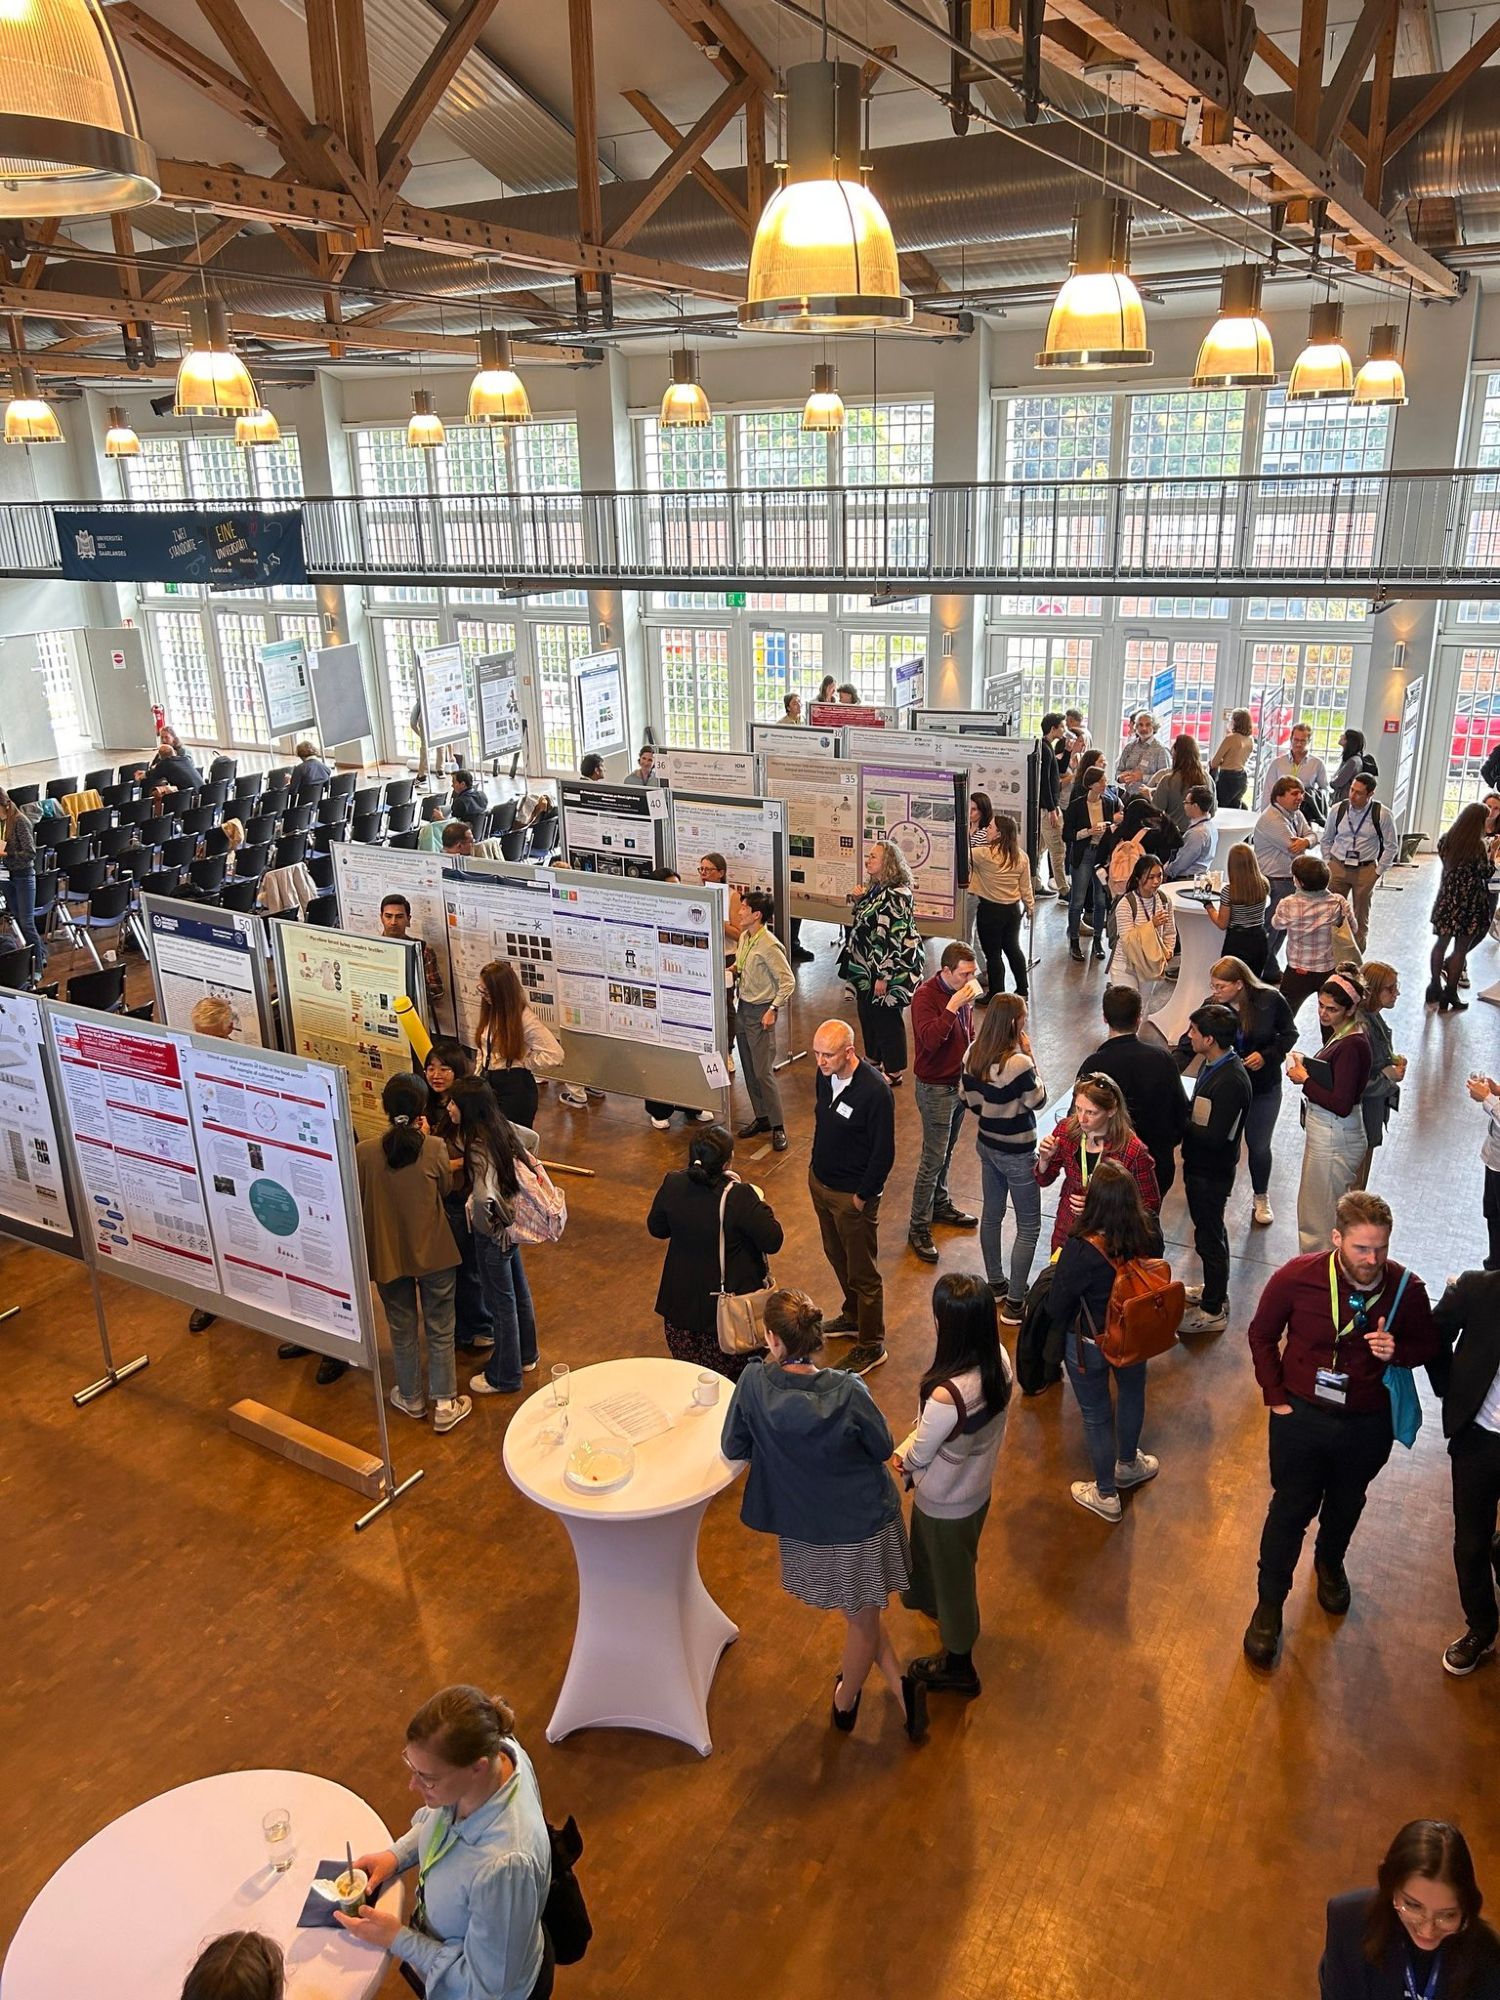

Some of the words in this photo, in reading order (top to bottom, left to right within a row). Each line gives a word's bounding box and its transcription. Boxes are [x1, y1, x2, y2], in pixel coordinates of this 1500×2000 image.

[172, 527, 187, 541] ZWEI
[215, 520, 237, 543] EINE
[657, 761, 666, 769] 36
[845, 775, 856, 783] 35
[650, 799, 661, 809] 40
[768, 810, 779, 820] 39
[239, 919, 251, 932] 50
[706, 1063, 719, 1075] 44
